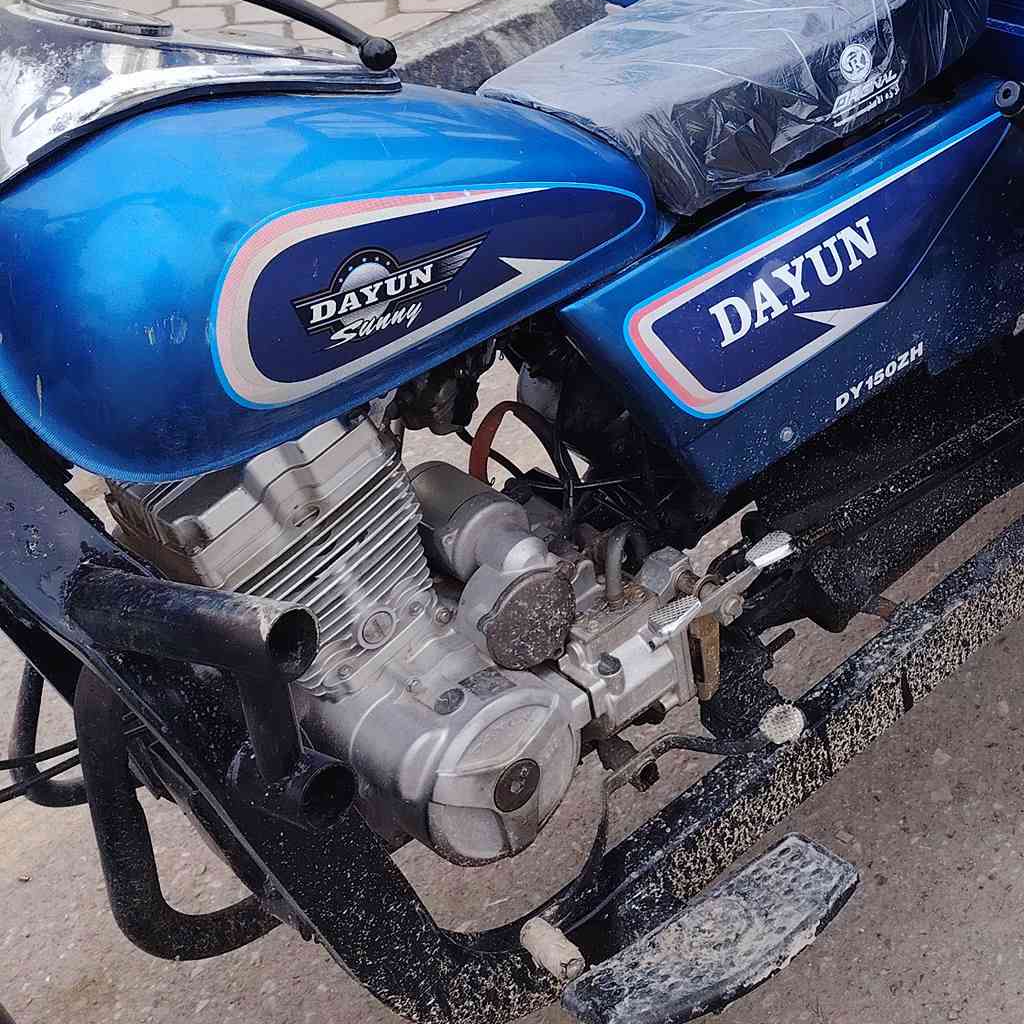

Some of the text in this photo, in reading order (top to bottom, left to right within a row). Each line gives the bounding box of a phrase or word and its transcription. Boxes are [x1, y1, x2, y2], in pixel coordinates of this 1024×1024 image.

[310, 263, 434, 324] DAYUN
[709, 216, 878, 348] DAYUN
[325, 301, 423, 350] Sunny
[835, 342, 924, 411] DY150ZH
